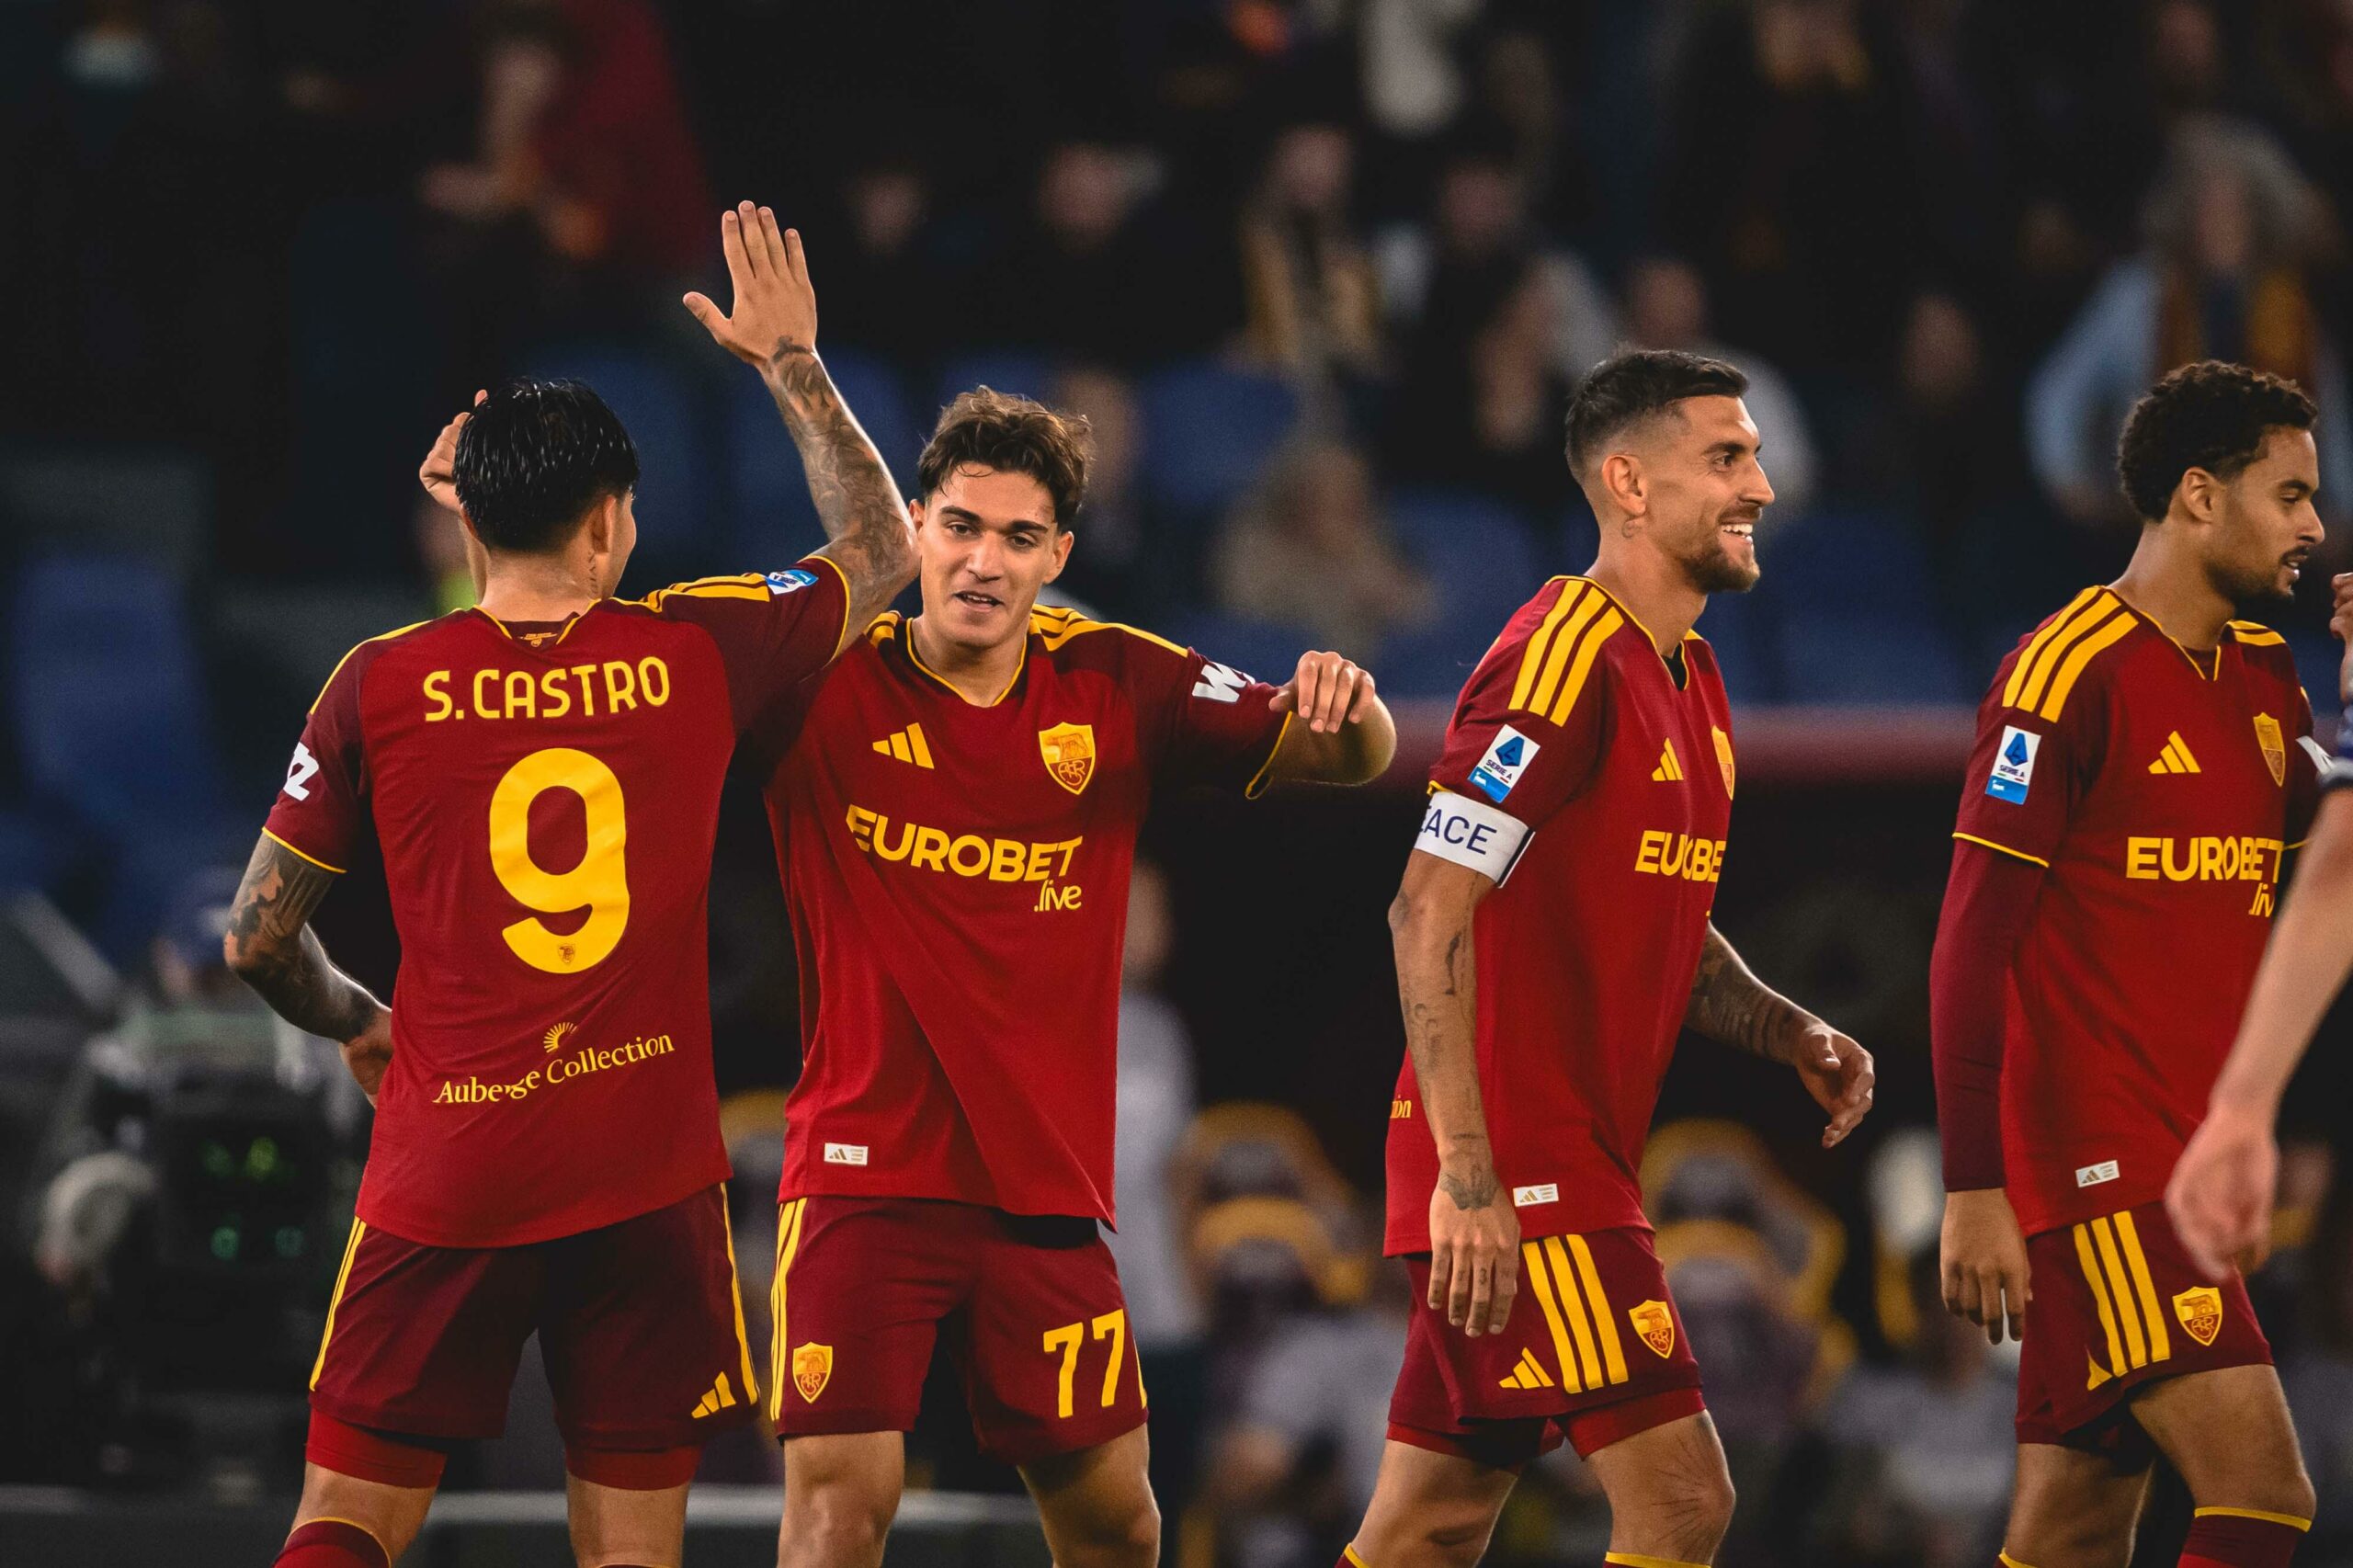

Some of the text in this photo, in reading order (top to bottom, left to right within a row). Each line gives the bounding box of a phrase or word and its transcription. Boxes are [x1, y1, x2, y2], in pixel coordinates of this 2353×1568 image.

[422, 656, 671, 722] S.CASTRO
[1486, 759, 1507, 776] SERIE
[846, 803, 1083, 882] EUROBET
[1421, 805, 1497, 856] ACE
[488, 747, 631, 974] 9
[2126, 836, 2284, 883] EUROBET
[1033, 880, 1083, 913] .live
[546, 1033, 676, 1085] Collection
[1043, 1309, 1125, 1418] 77
